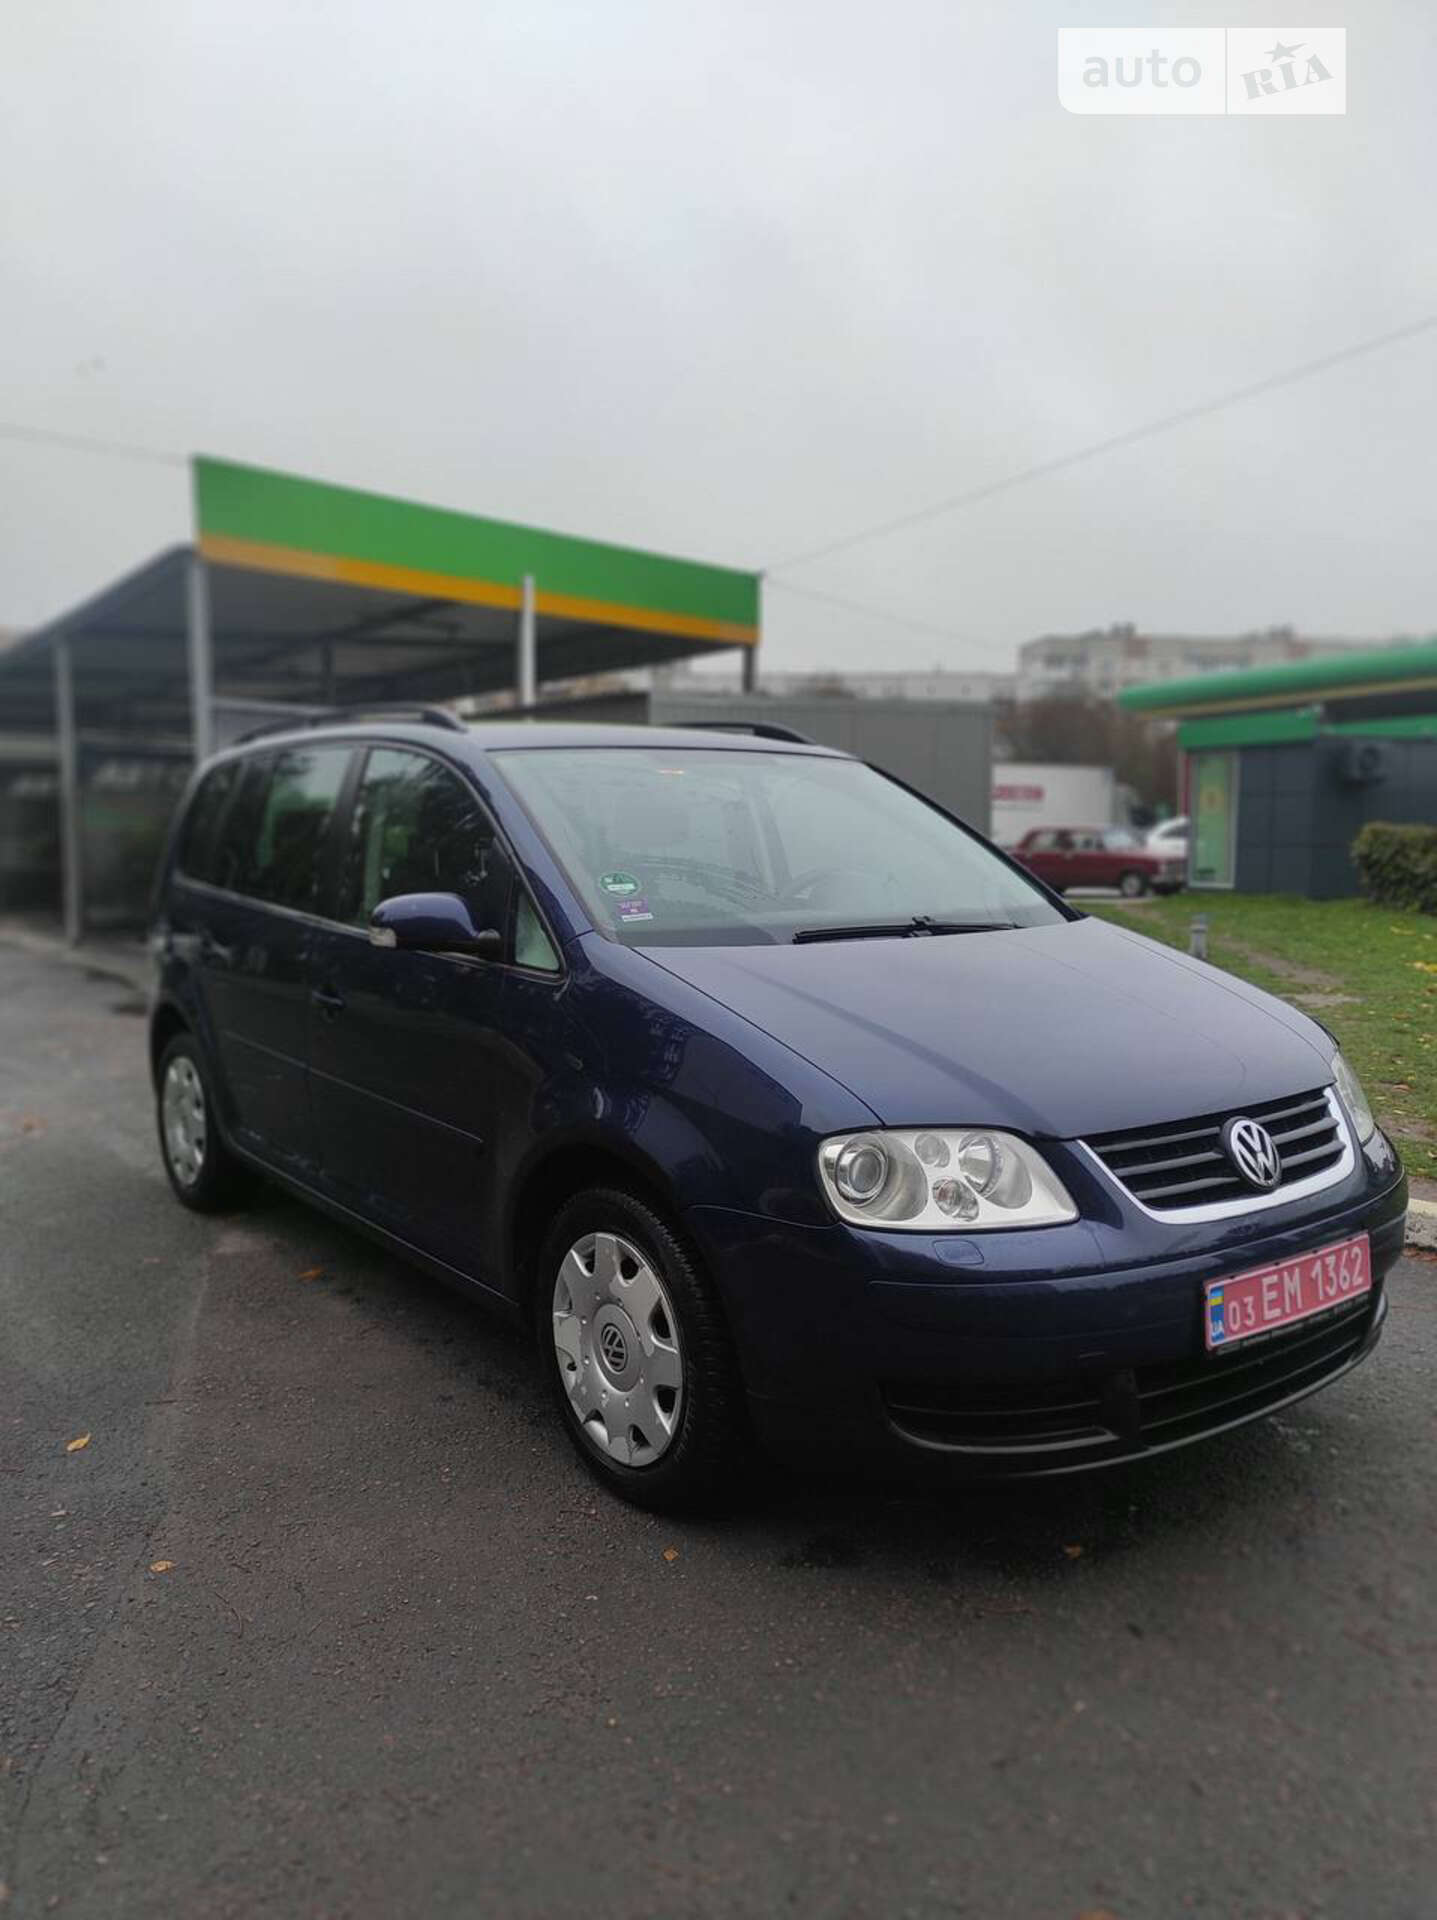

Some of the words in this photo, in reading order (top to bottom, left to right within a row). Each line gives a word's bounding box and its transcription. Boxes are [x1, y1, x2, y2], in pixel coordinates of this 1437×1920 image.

[1228, 1296, 1255, 1331] 03
[1261, 1268, 1302, 1320] EM
[1311, 1246, 1364, 1300] 1362
